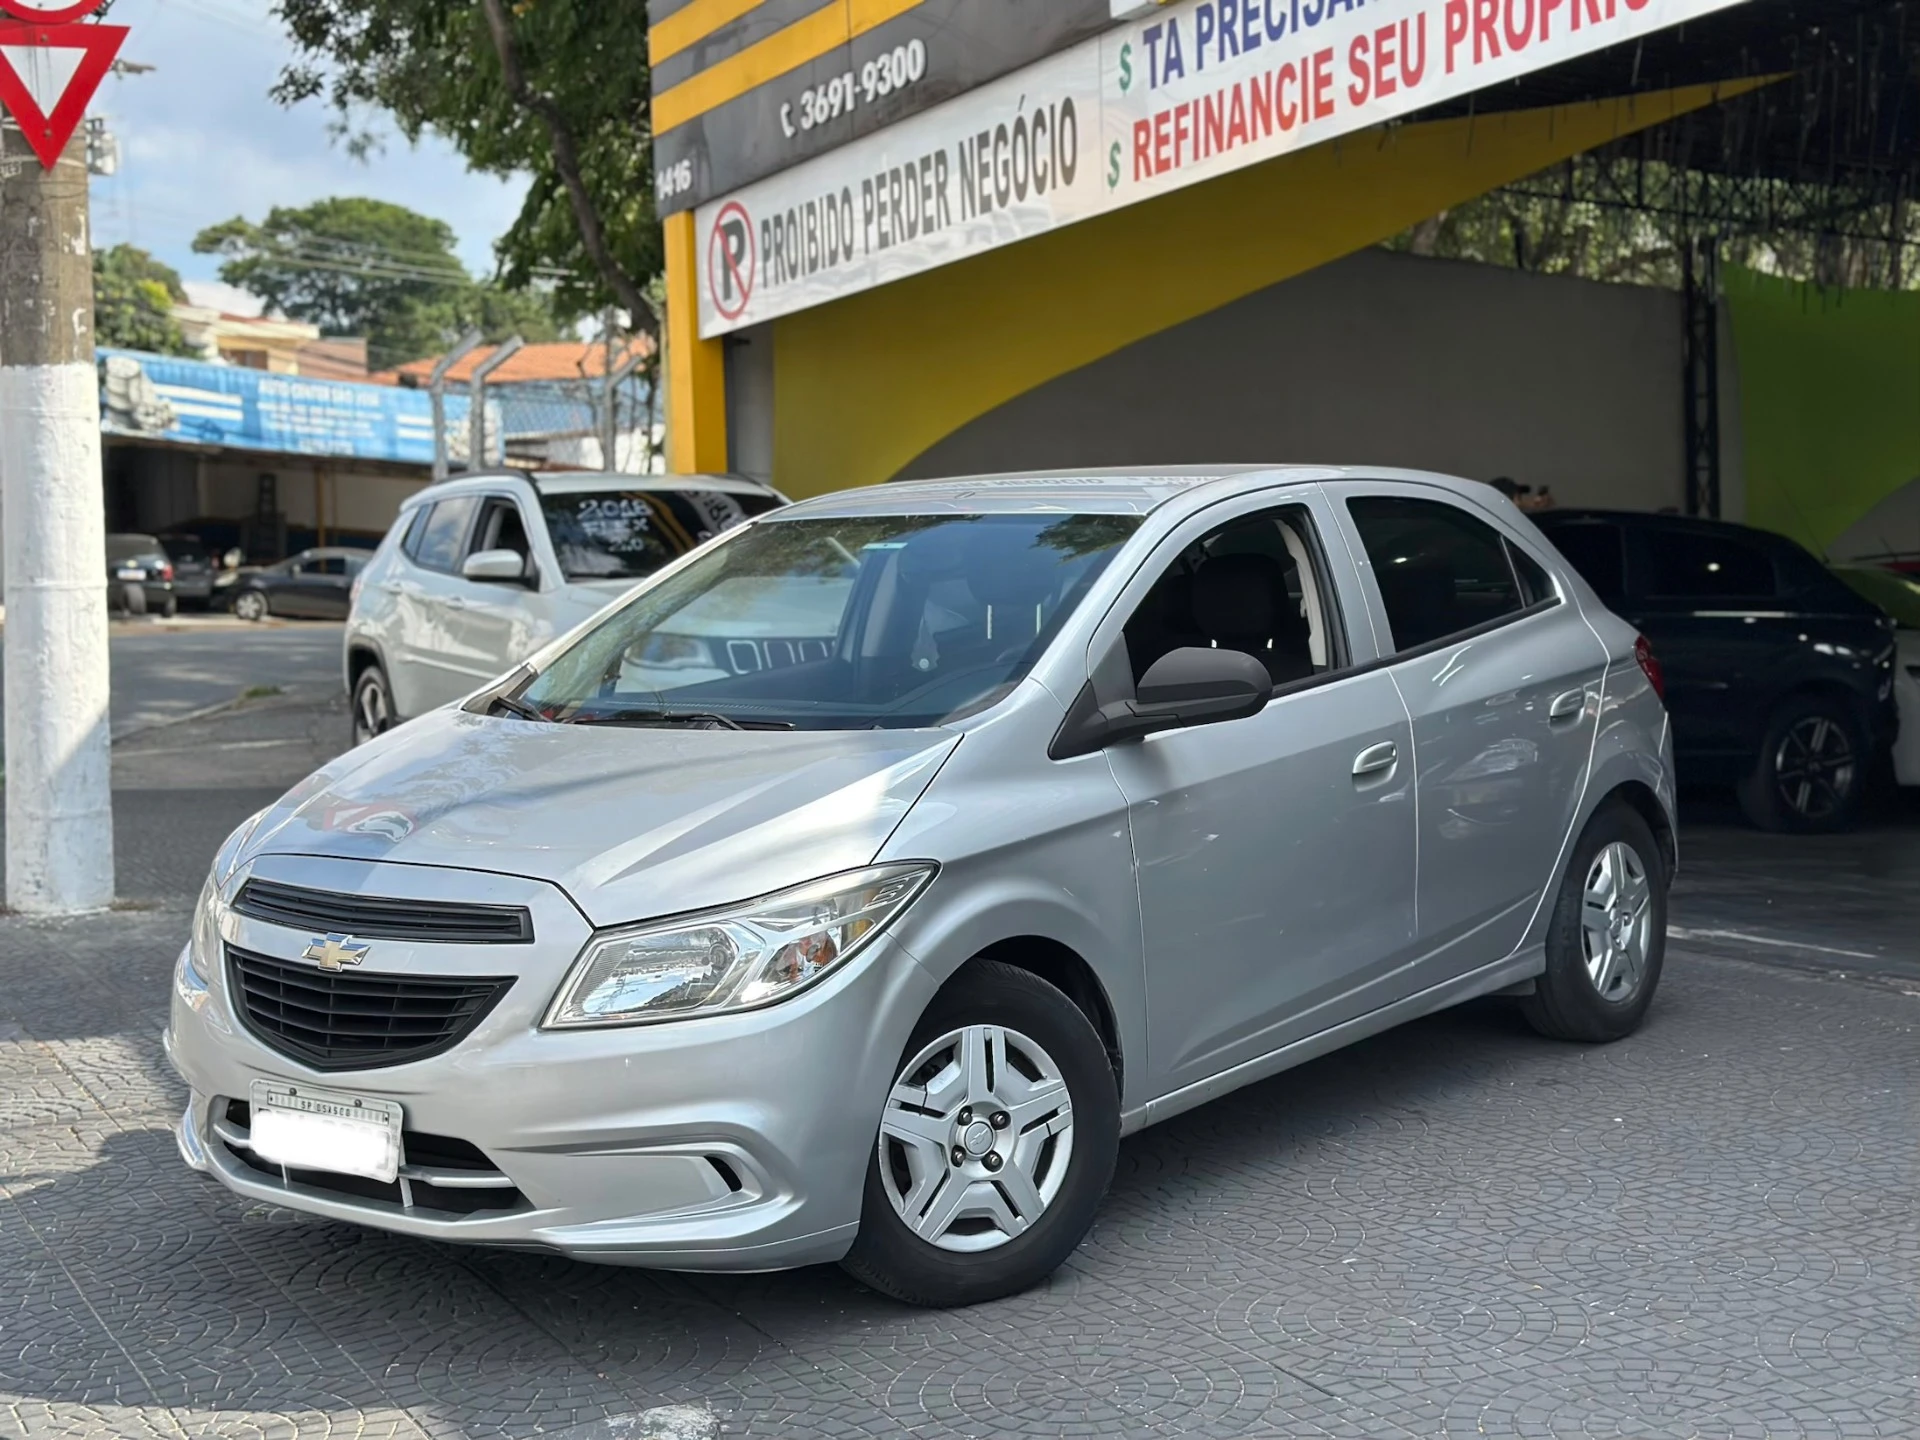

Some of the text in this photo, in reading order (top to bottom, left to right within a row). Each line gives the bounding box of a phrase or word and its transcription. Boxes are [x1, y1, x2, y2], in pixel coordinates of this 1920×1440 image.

[800, 38, 927, 130] 3691-9300
[1142, 16, 1185, 90] TA
[1196, 0, 1365, 71] PREC
[1133, 46, 1335, 182] REFINANCIE
[1347, 11, 1426, 107] SEU
[1444, 0, 1650, 75] PROP
[655, 158, 692, 201] 1416
[761, 185, 855, 290] PROIBIDO
[861, 148, 952, 256] PERDER
[957, 93, 1078, 222] NEGÓCIO
[301, 1100, 351, 1117] SP OSASCO
